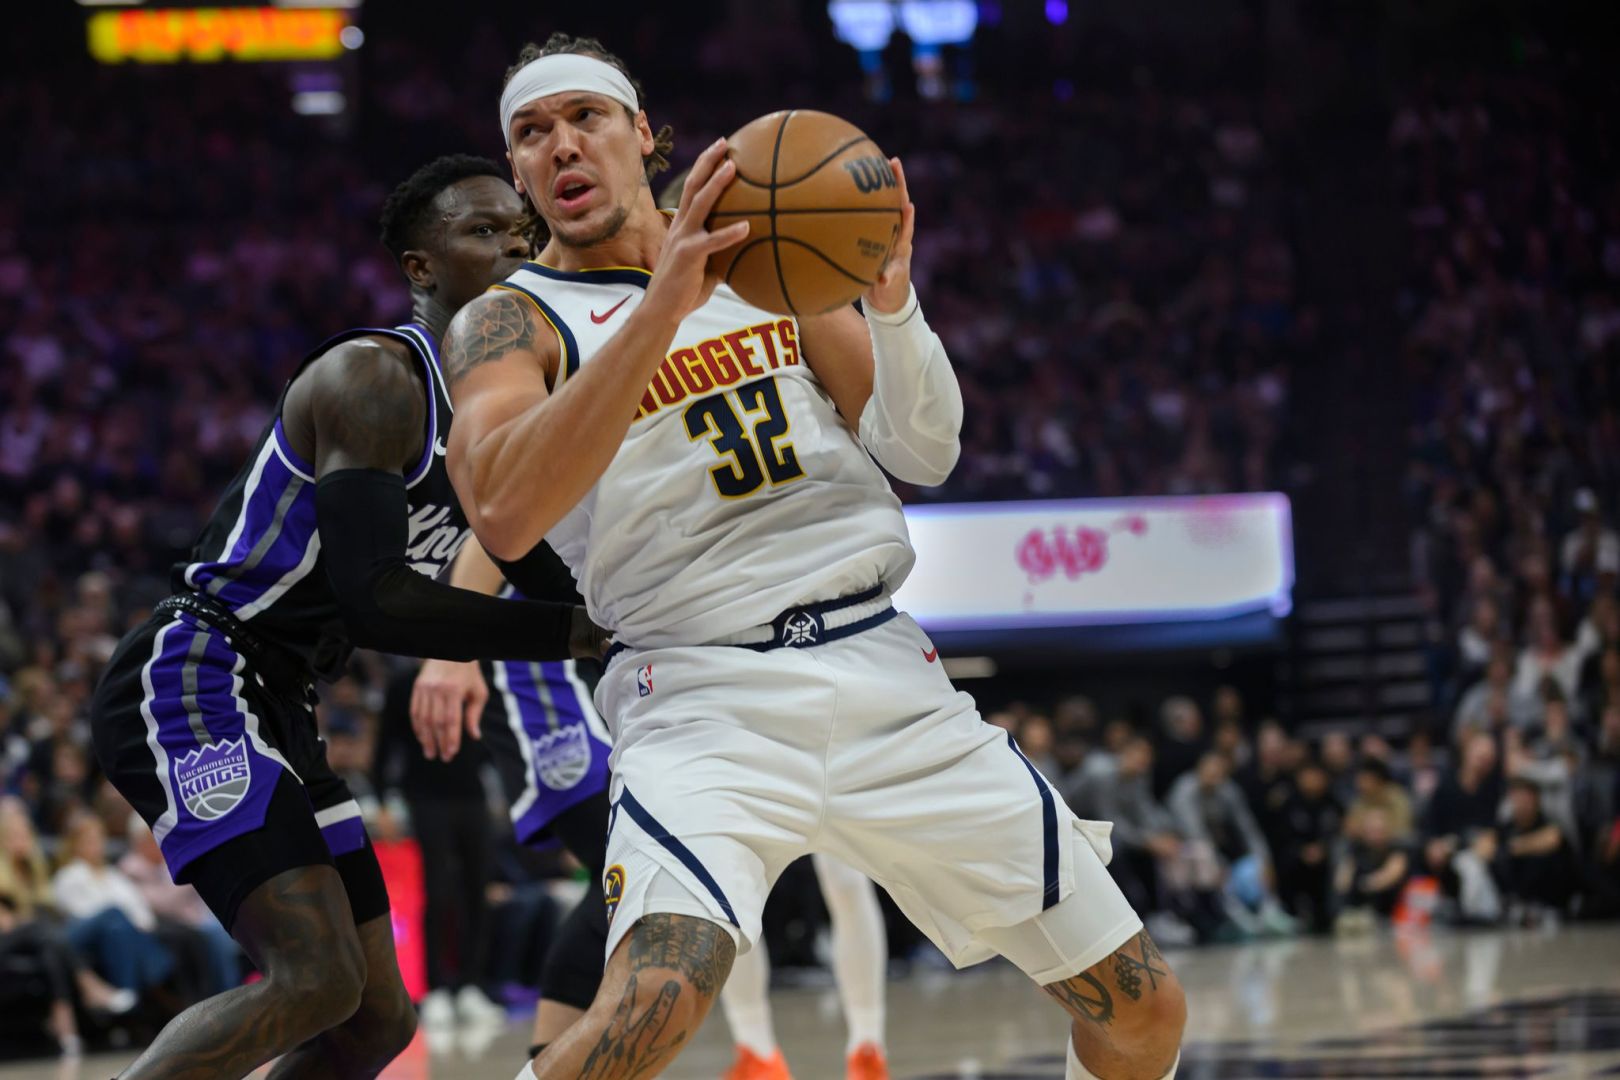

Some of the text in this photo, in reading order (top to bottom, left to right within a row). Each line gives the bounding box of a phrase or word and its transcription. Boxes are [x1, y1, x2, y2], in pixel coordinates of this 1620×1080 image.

[681, 374, 808, 500] 32
[180, 754, 243, 782] SACRAMENTO
[181, 765, 248, 801] KINGS
